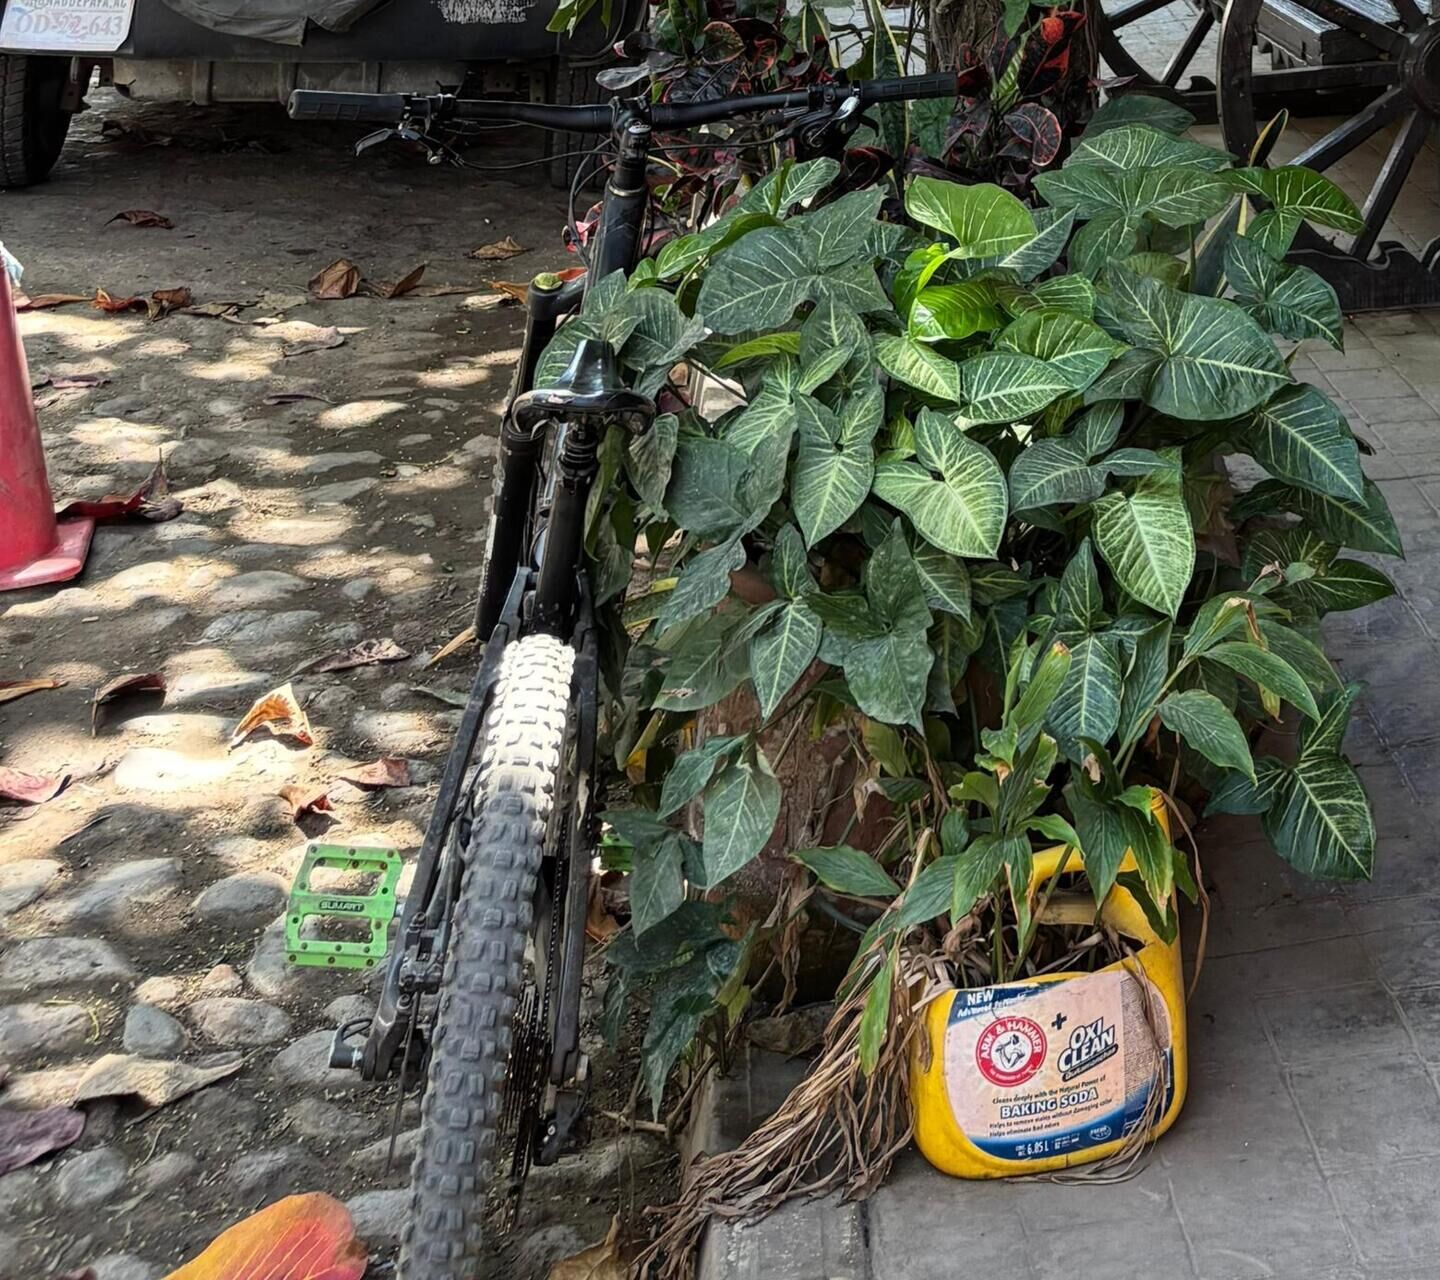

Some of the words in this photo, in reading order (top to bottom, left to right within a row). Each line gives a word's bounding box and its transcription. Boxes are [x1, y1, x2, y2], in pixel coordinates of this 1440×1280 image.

[967, 989, 995, 1006] NEW
[981, 1032, 996, 1059] ARM
[1007, 1020, 1042, 1054] HAMMER
[1058, 1024, 1115, 1073] CLEAN
[1070, 1017, 1103, 1050] OXI
[1001, 1098, 1057, 1119] BAKING
[1060, 1086, 1099, 1109] SODA
